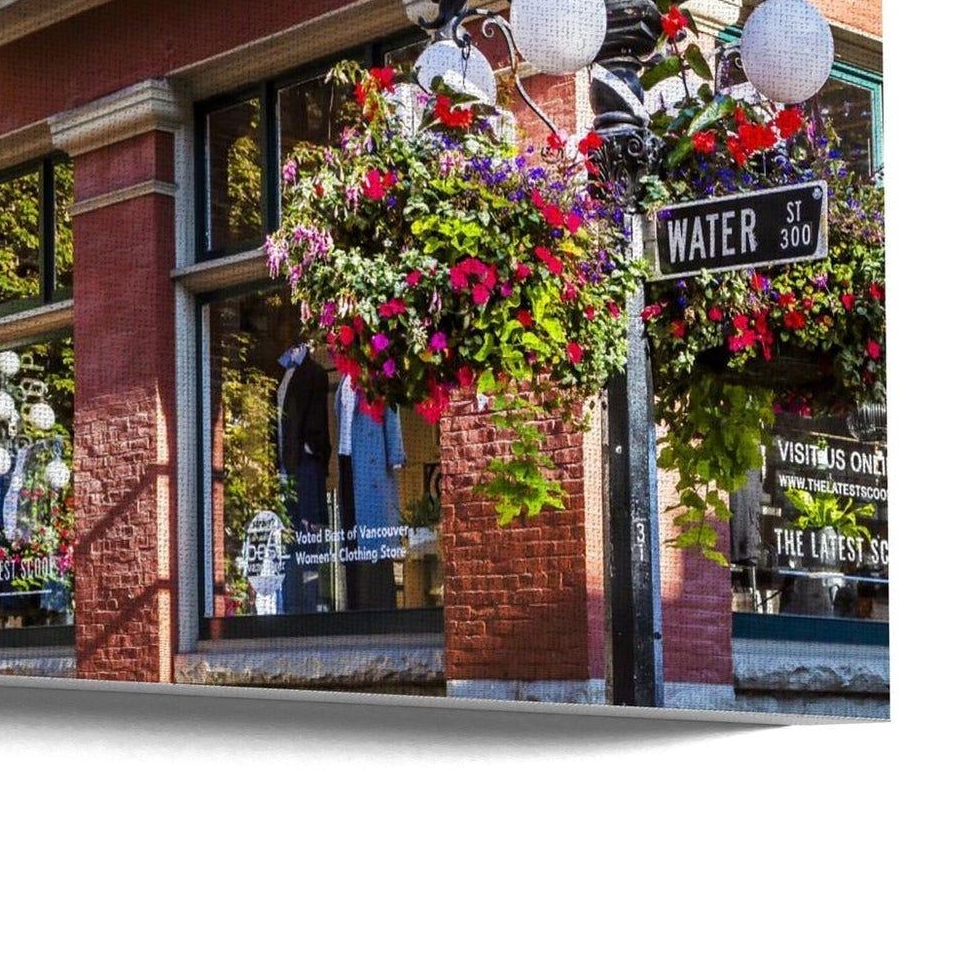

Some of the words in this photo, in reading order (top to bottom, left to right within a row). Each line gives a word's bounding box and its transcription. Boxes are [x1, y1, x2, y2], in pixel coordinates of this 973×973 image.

[786, 200, 802, 224] ST
[667, 208, 758, 264] WATER
[780, 224, 812, 250] 300
[777, 440, 819, 467] VISIT
[826, 445, 847, 471] US
[850, 451, 888, 477] ONLI
[295, 529, 322, 545] Voted
[325, 528, 345, 542] Best
[347, 526, 358, 540] of
[359, 525, 409, 539] Vancouver
[774, 527, 804, 557] THE
[811, 532, 864, 563] LATEST
[339, 547, 378, 564] Clothing
[380, 544, 407, 559] Store
